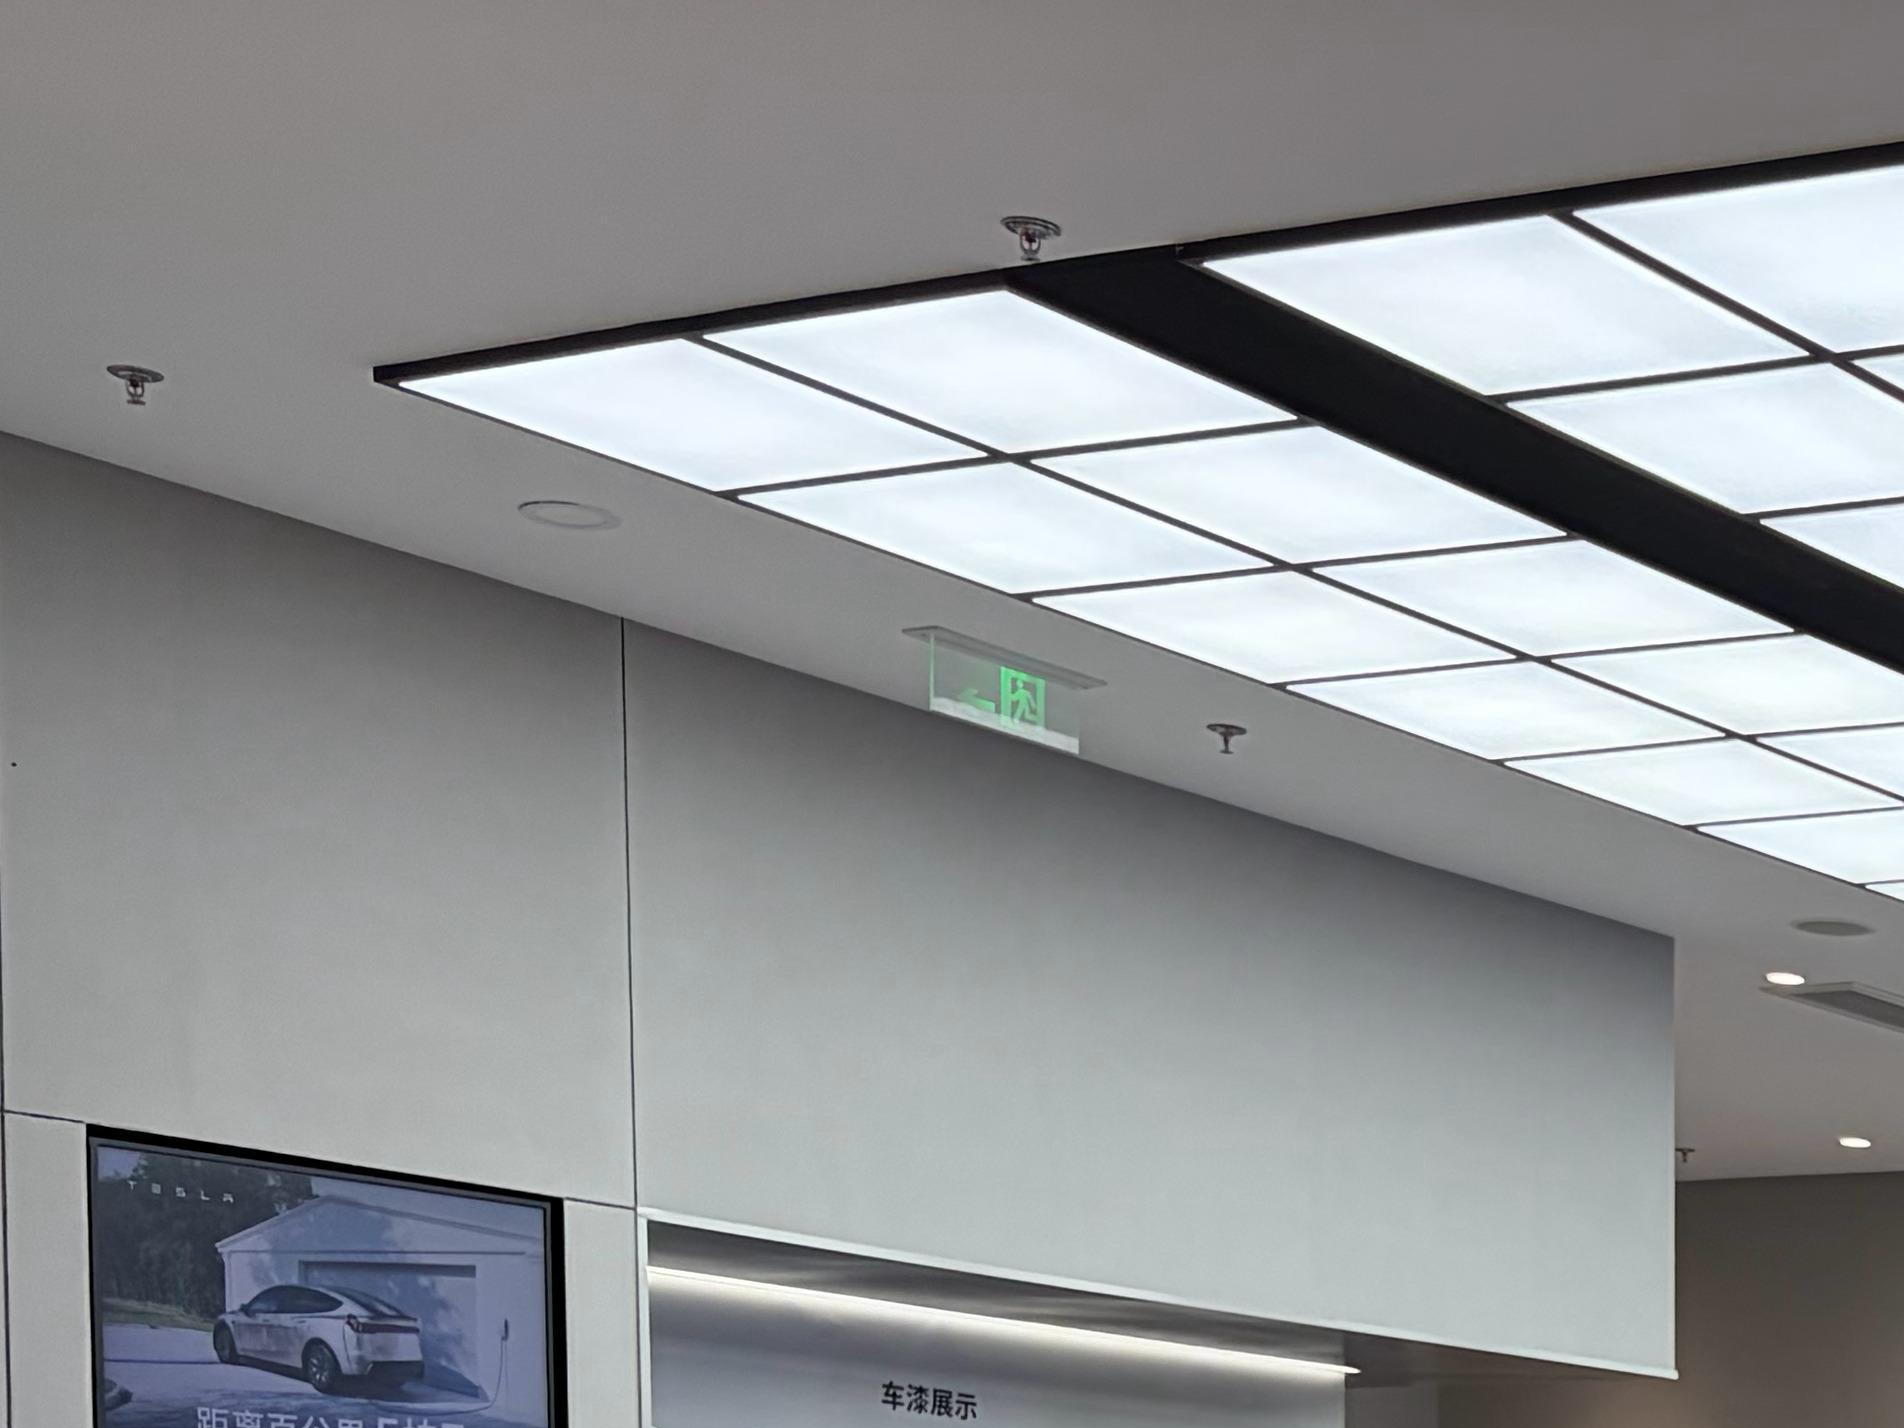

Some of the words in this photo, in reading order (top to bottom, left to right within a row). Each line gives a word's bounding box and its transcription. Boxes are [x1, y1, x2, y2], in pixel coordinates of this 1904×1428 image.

[128, 1179, 235, 1203] TESLA
[881, 1380, 978, 1420] 车漆展示
